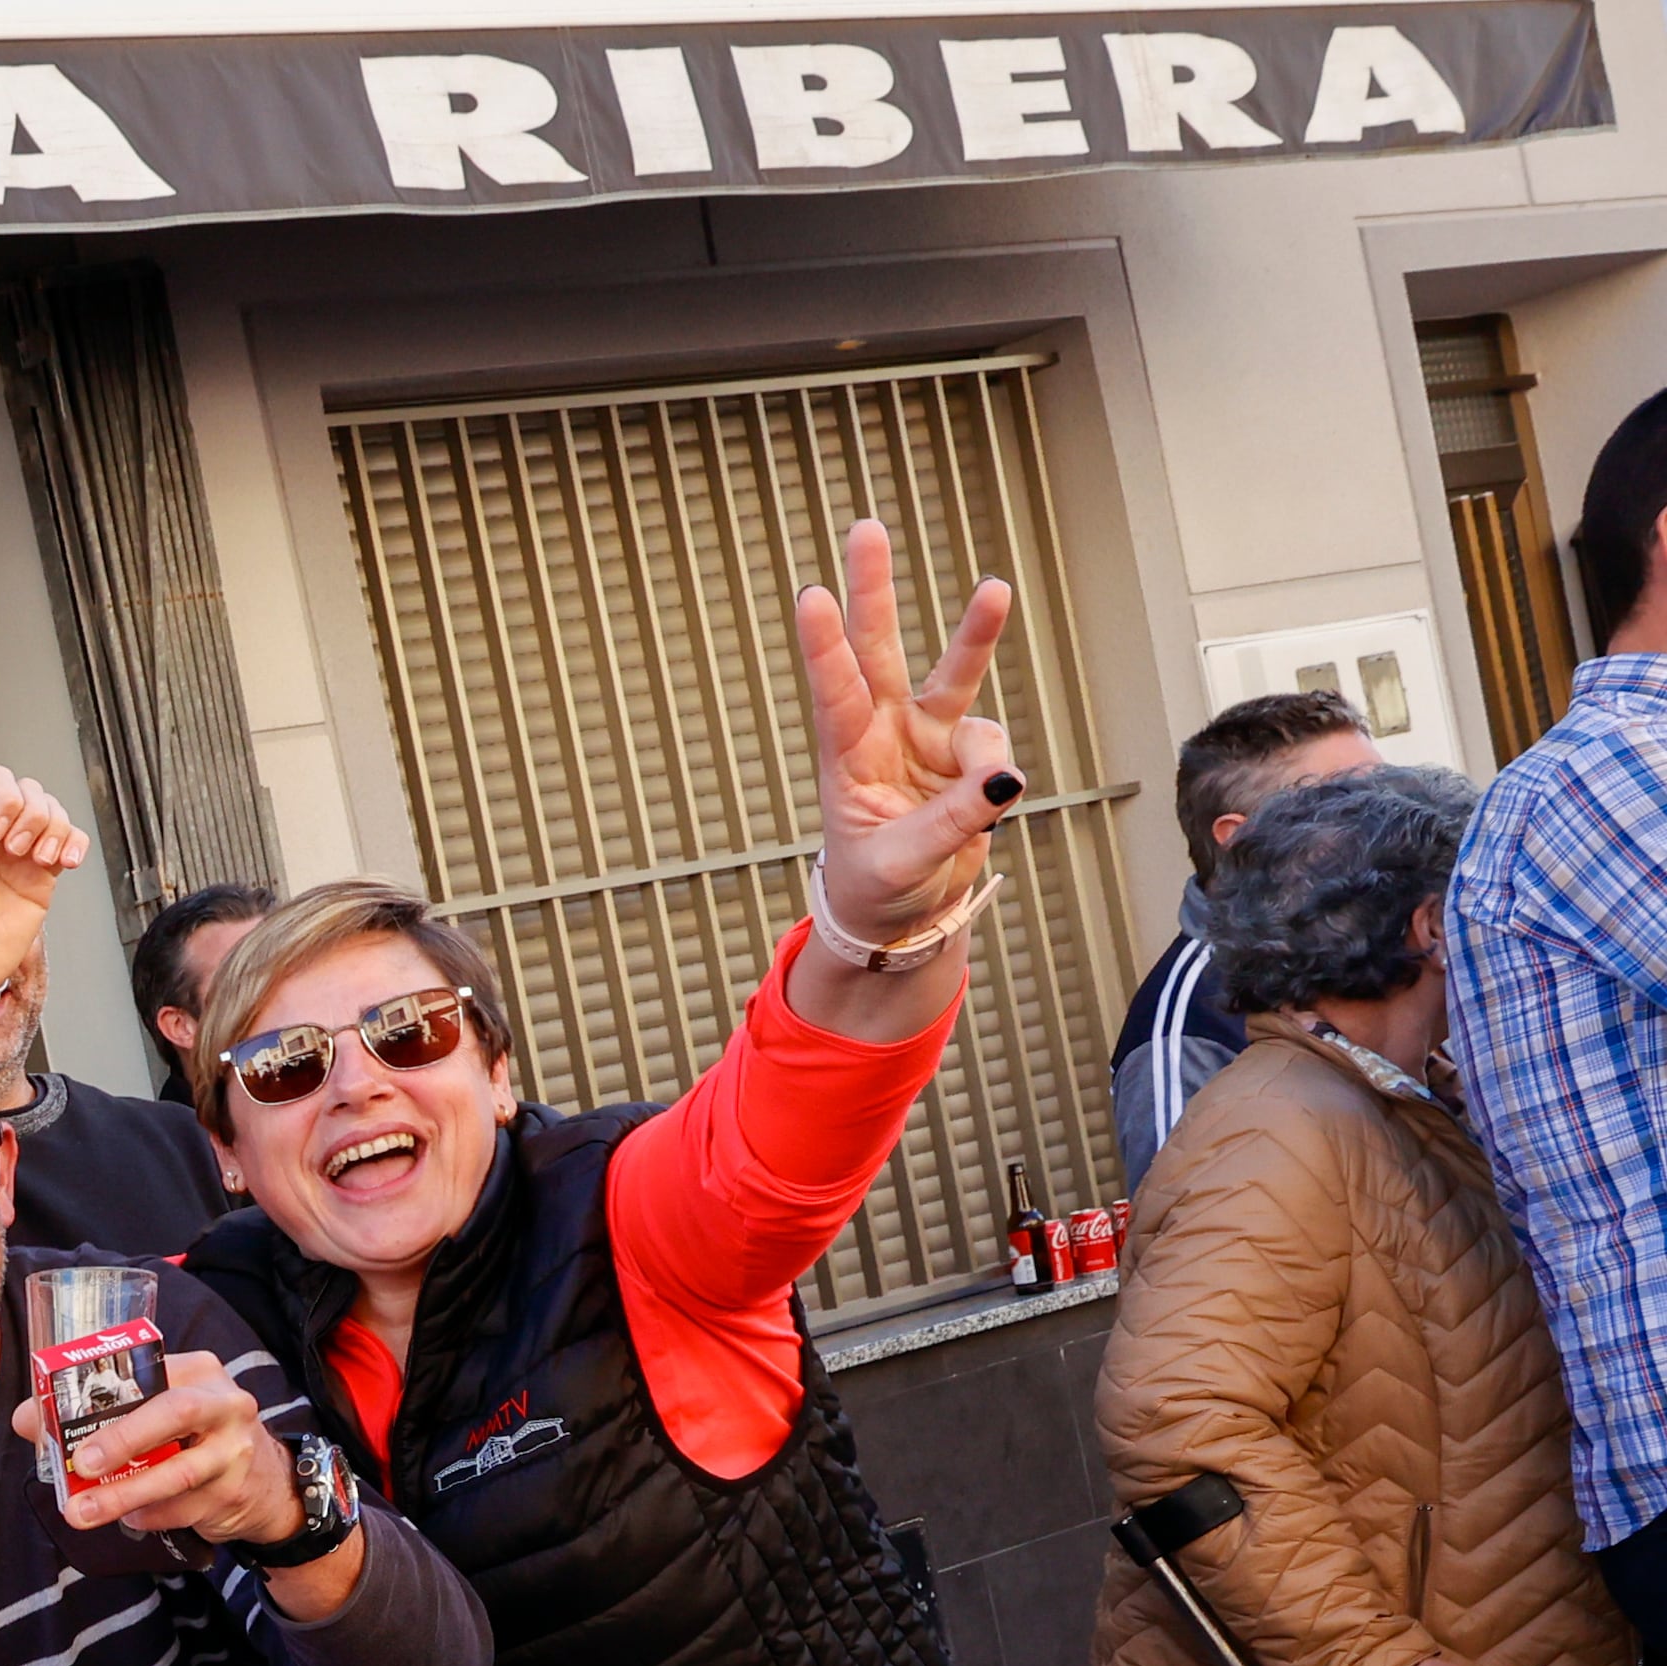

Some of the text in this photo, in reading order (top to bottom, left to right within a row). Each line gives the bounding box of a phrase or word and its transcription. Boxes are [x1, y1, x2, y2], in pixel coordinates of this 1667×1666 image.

[359, 25, 1467, 190] RIBERA
[62, 1336, 134, 1362] Winston
[64, 1422, 98, 1440] Fumar
